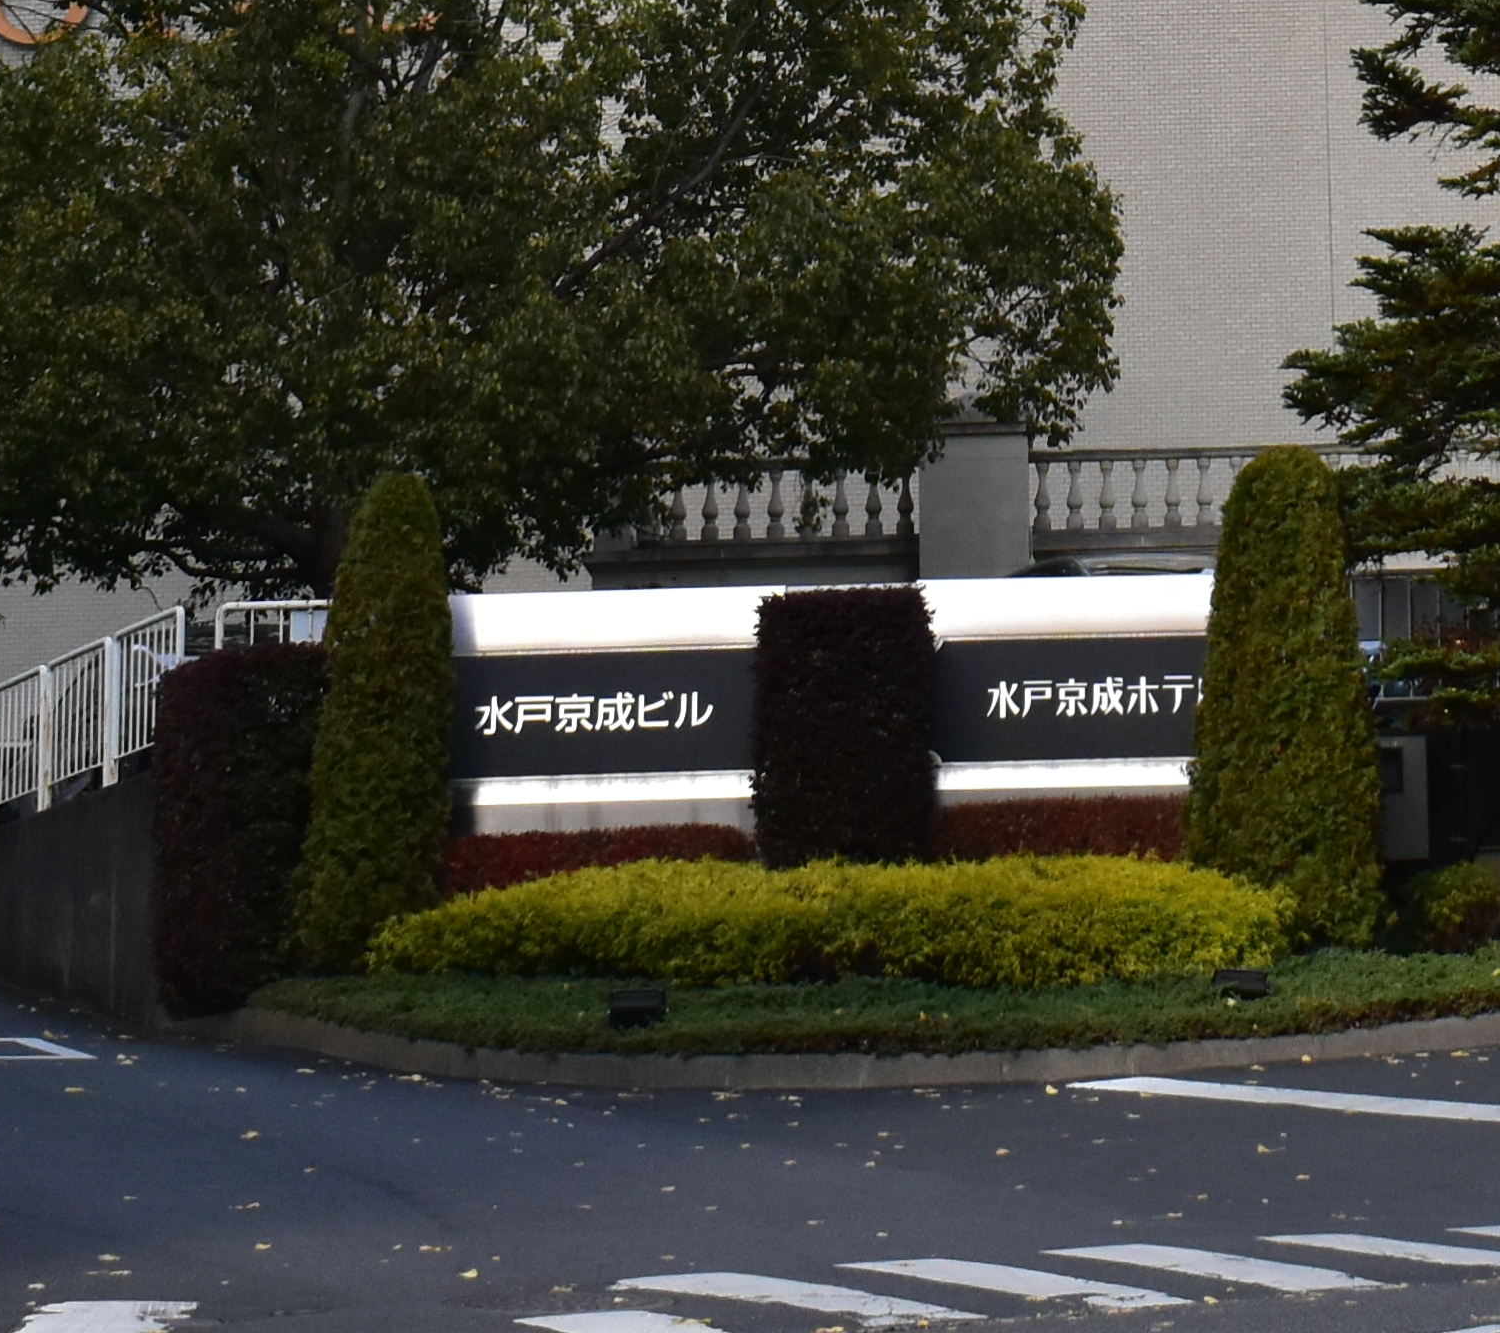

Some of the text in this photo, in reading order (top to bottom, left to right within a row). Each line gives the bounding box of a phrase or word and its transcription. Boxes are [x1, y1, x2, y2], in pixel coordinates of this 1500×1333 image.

[474, 690, 715, 737] 水戸京成ビル
